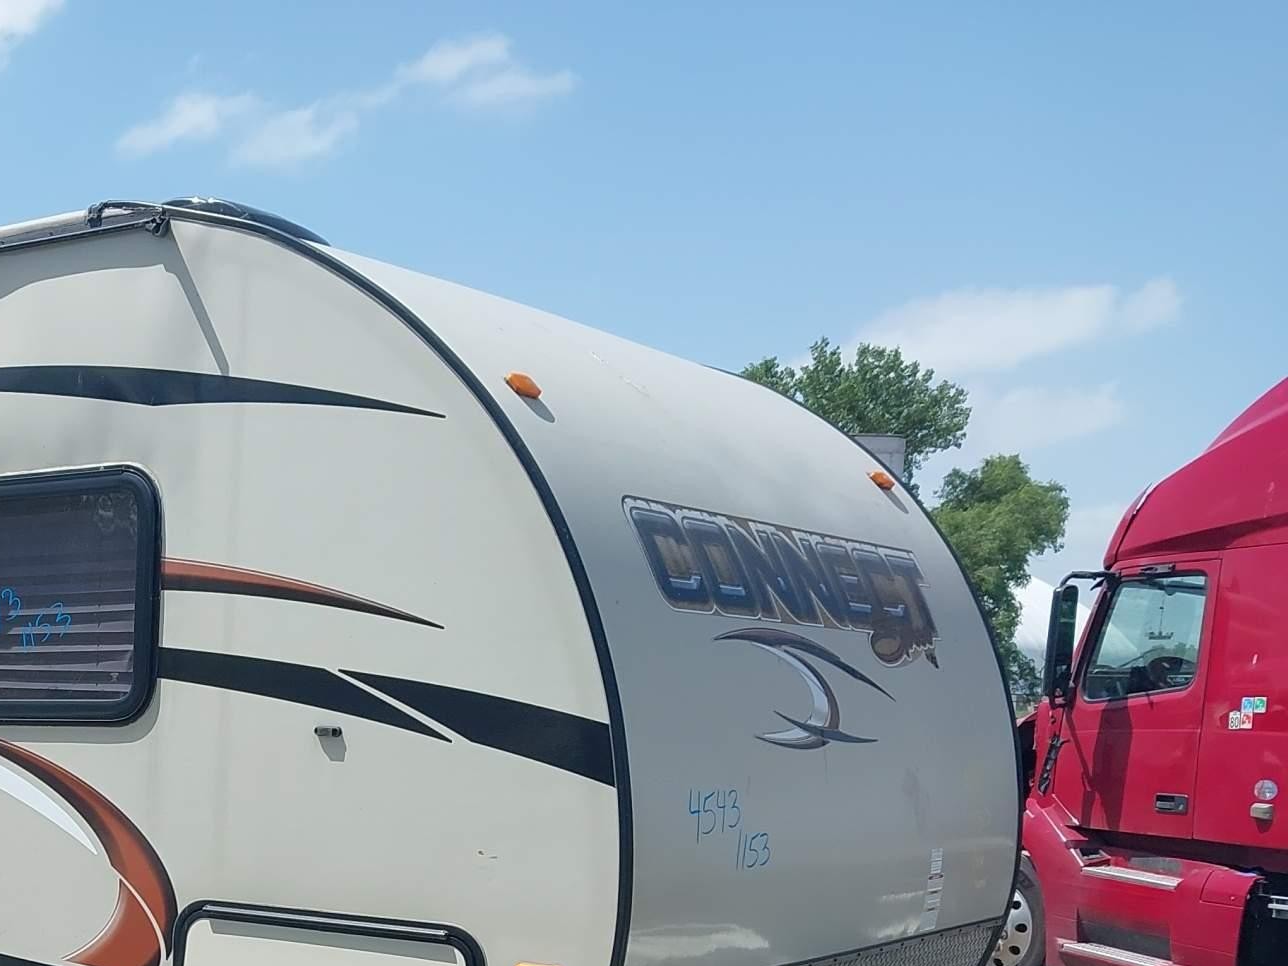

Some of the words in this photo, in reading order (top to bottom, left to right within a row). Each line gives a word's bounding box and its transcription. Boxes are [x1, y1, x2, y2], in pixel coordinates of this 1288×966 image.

[622, 498, 940, 642] CONNECT
[21, 602, 72, 654] 1153
[688, 788, 741, 845] 4543
[736, 829, 771, 870] 1153
